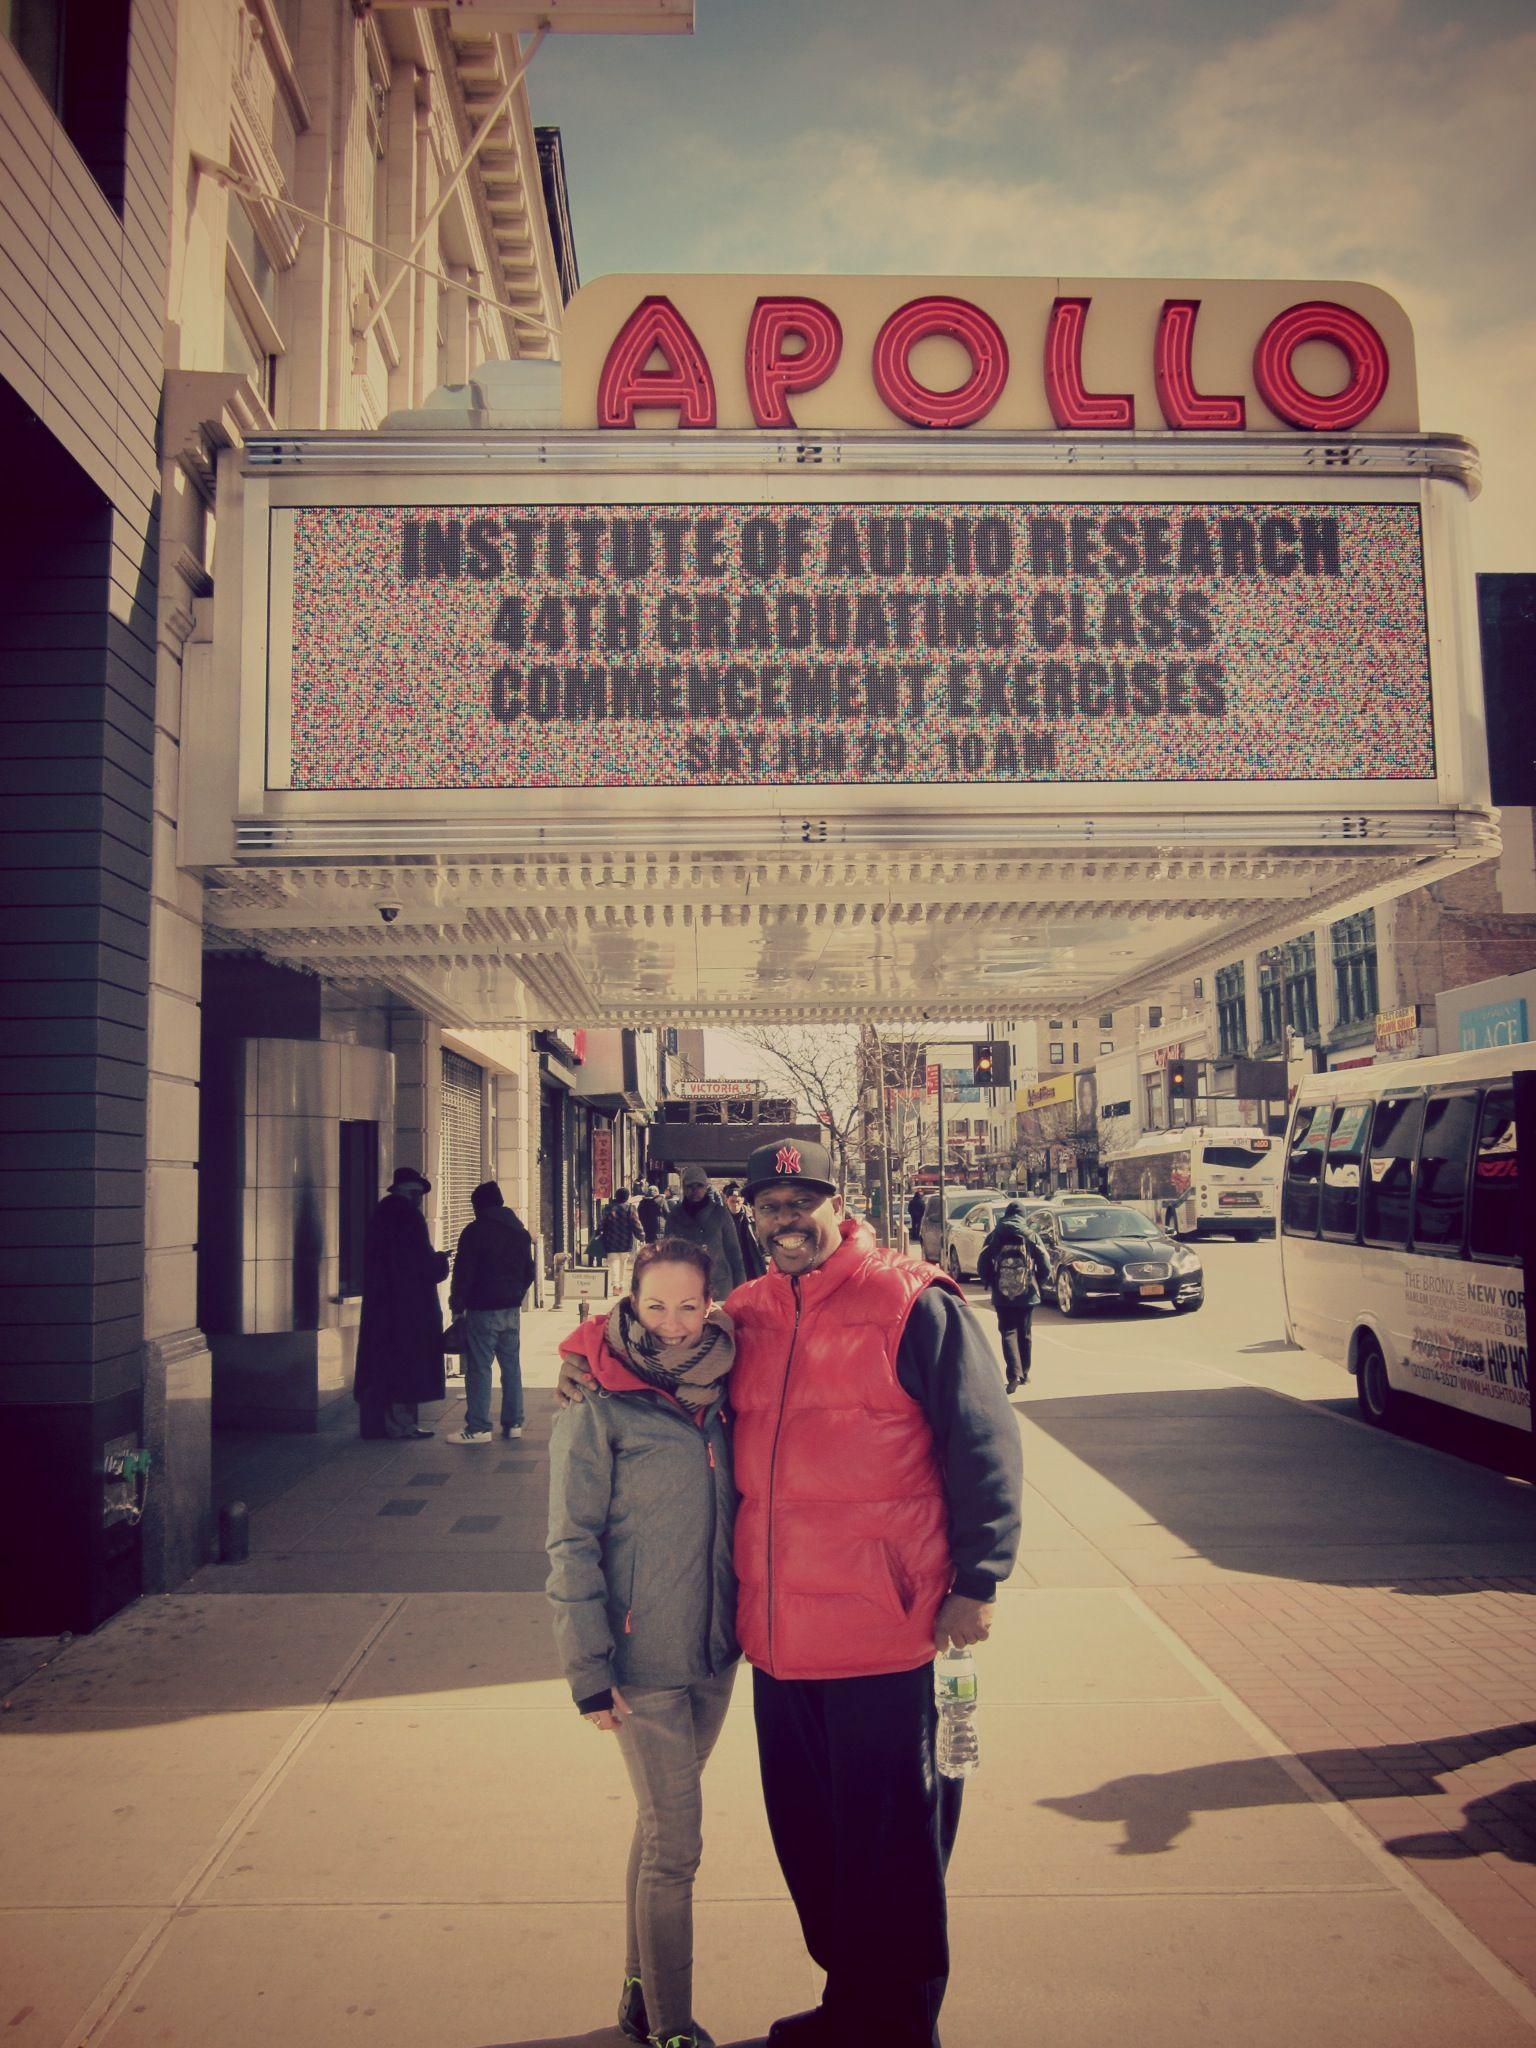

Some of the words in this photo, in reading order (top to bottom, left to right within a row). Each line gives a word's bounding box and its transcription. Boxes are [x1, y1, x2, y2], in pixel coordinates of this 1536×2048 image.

[598, 295, 1390, 431] APOLLO
[402, 517, 726, 580] INSTITUTE
[741, 516, 812, 579] OF
[825, 516, 1013, 578] AUDIO
[1029, 516, 1339, 577] RESEARCH
[492, 594, 640, 651] 44TH
[658, 593, 1015, 651] GRADUATING
[1030, 592, 1213, 651] CLASS
[492, 662, 931, 722] COMMENCEMENT
[947, 661, 1225, 717] EXERCISES
[684, 733, 767, 774] SAT
[857, 732, 906, 773] 29
[1397, 1015, 1415, 1031] SHOP
[690, 1083, 739, 1094] VICTORIA
[775, 1146, 802, 1174] NY
[1405, 1272, 1421, 1290] THE
[1422, 1275, 1456, 1297] BRONX
[1466, 1283, 1497, 1305] NEW
[1485, 1337, 1508, 1386] HIP
